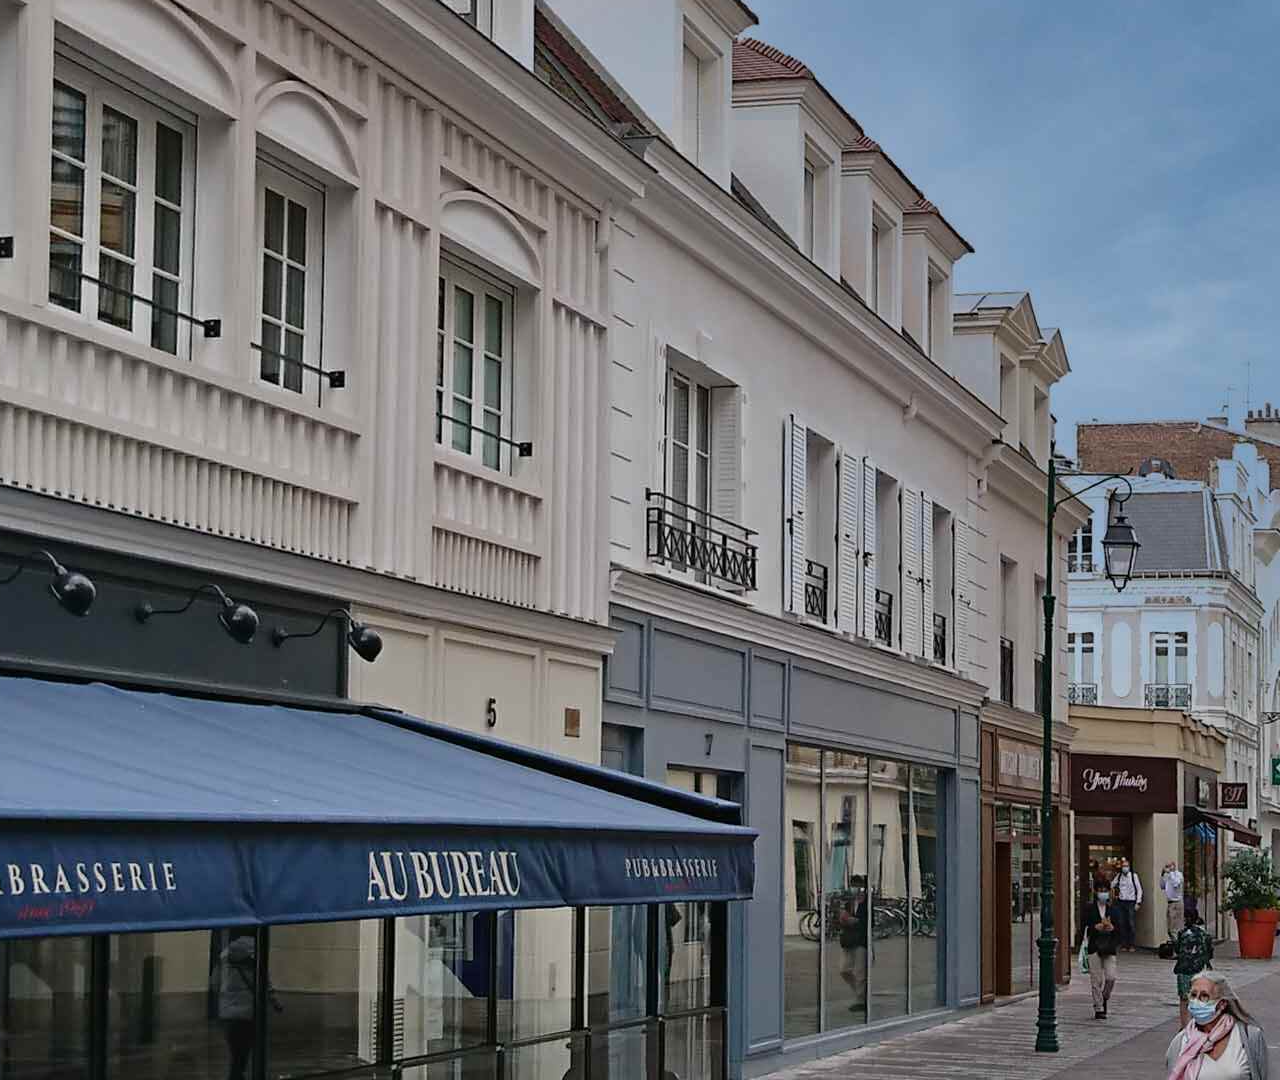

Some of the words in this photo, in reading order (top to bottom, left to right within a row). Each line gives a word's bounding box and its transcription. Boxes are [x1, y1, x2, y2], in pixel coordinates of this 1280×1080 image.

[486, 697, 497, 728] 5
[705, 733, 714, 756] 7
[367, 851, 409, 901] AU
[411, 851, 520, 899] BUREAU
[624, 858, 718, 878] PUB&BRASSERIE
